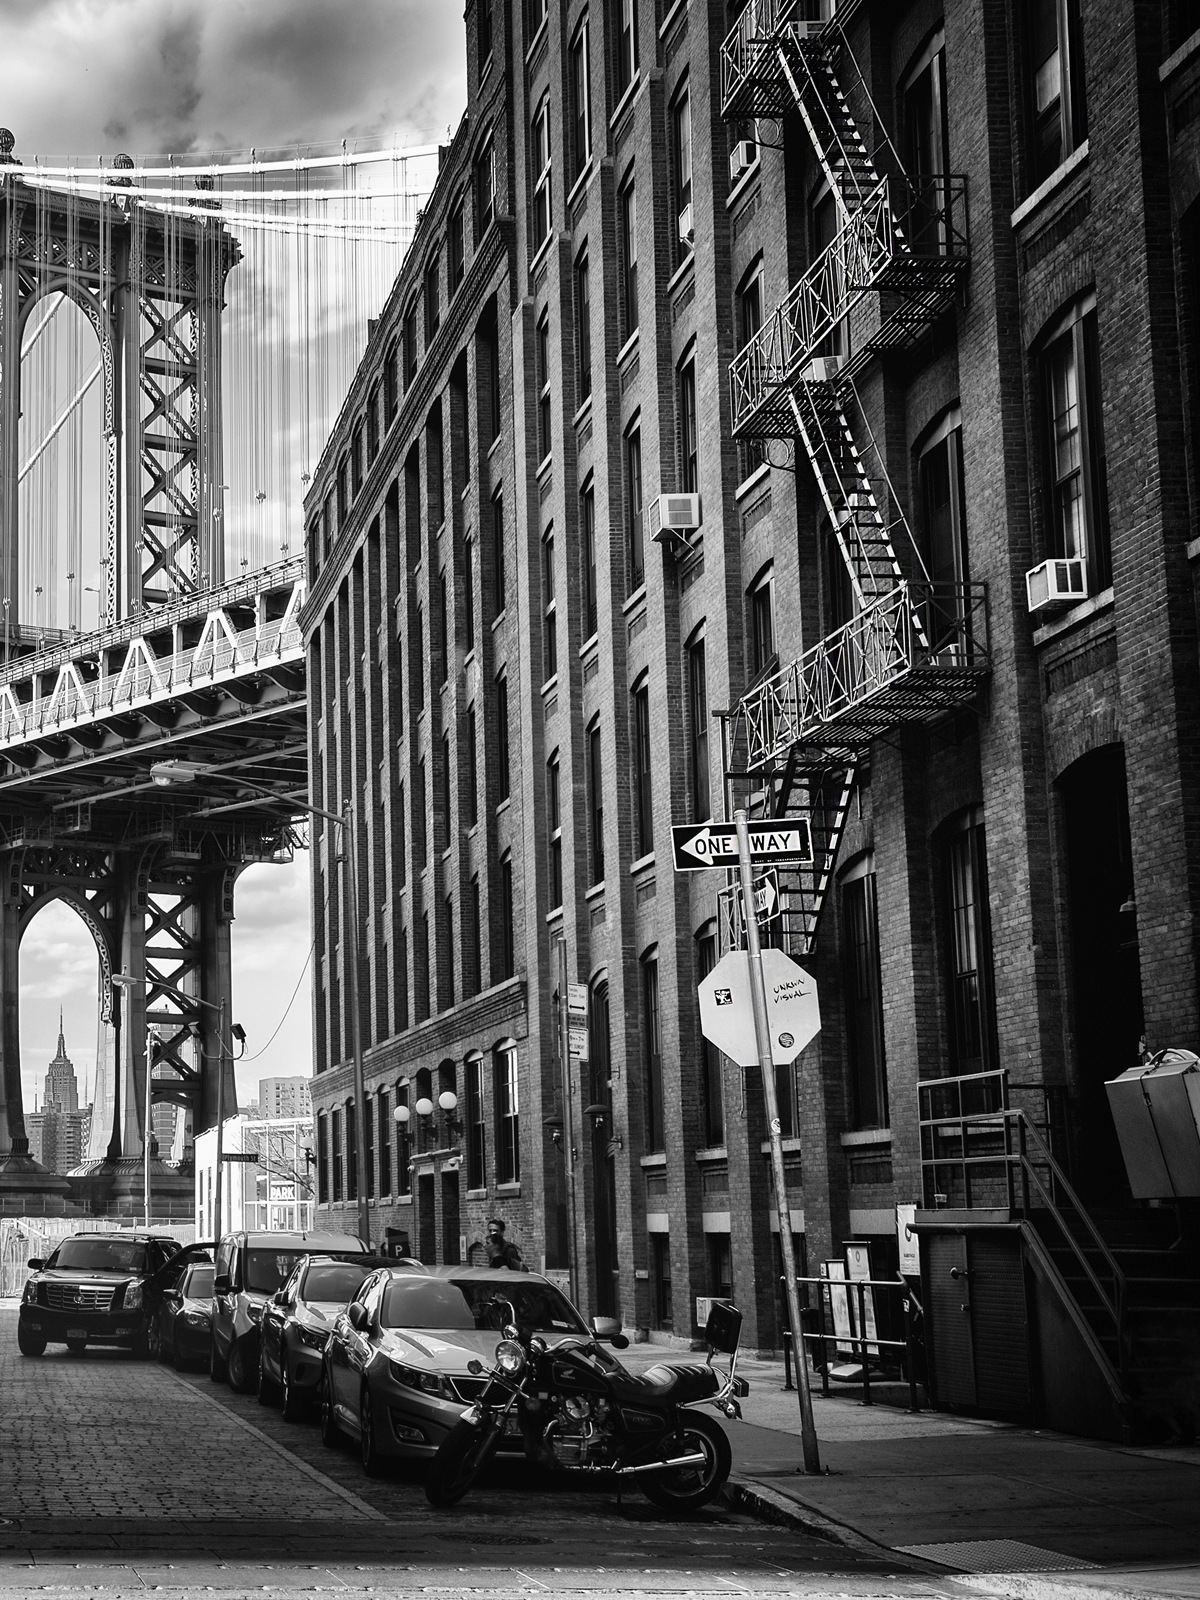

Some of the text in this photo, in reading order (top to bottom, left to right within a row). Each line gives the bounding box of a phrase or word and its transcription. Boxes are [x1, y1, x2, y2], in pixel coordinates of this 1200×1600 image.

[695, 833, 791, 855] ONE WAY
[271, 1186, 295, 1198] PARK
[395, 1245, 403, 1256] P
